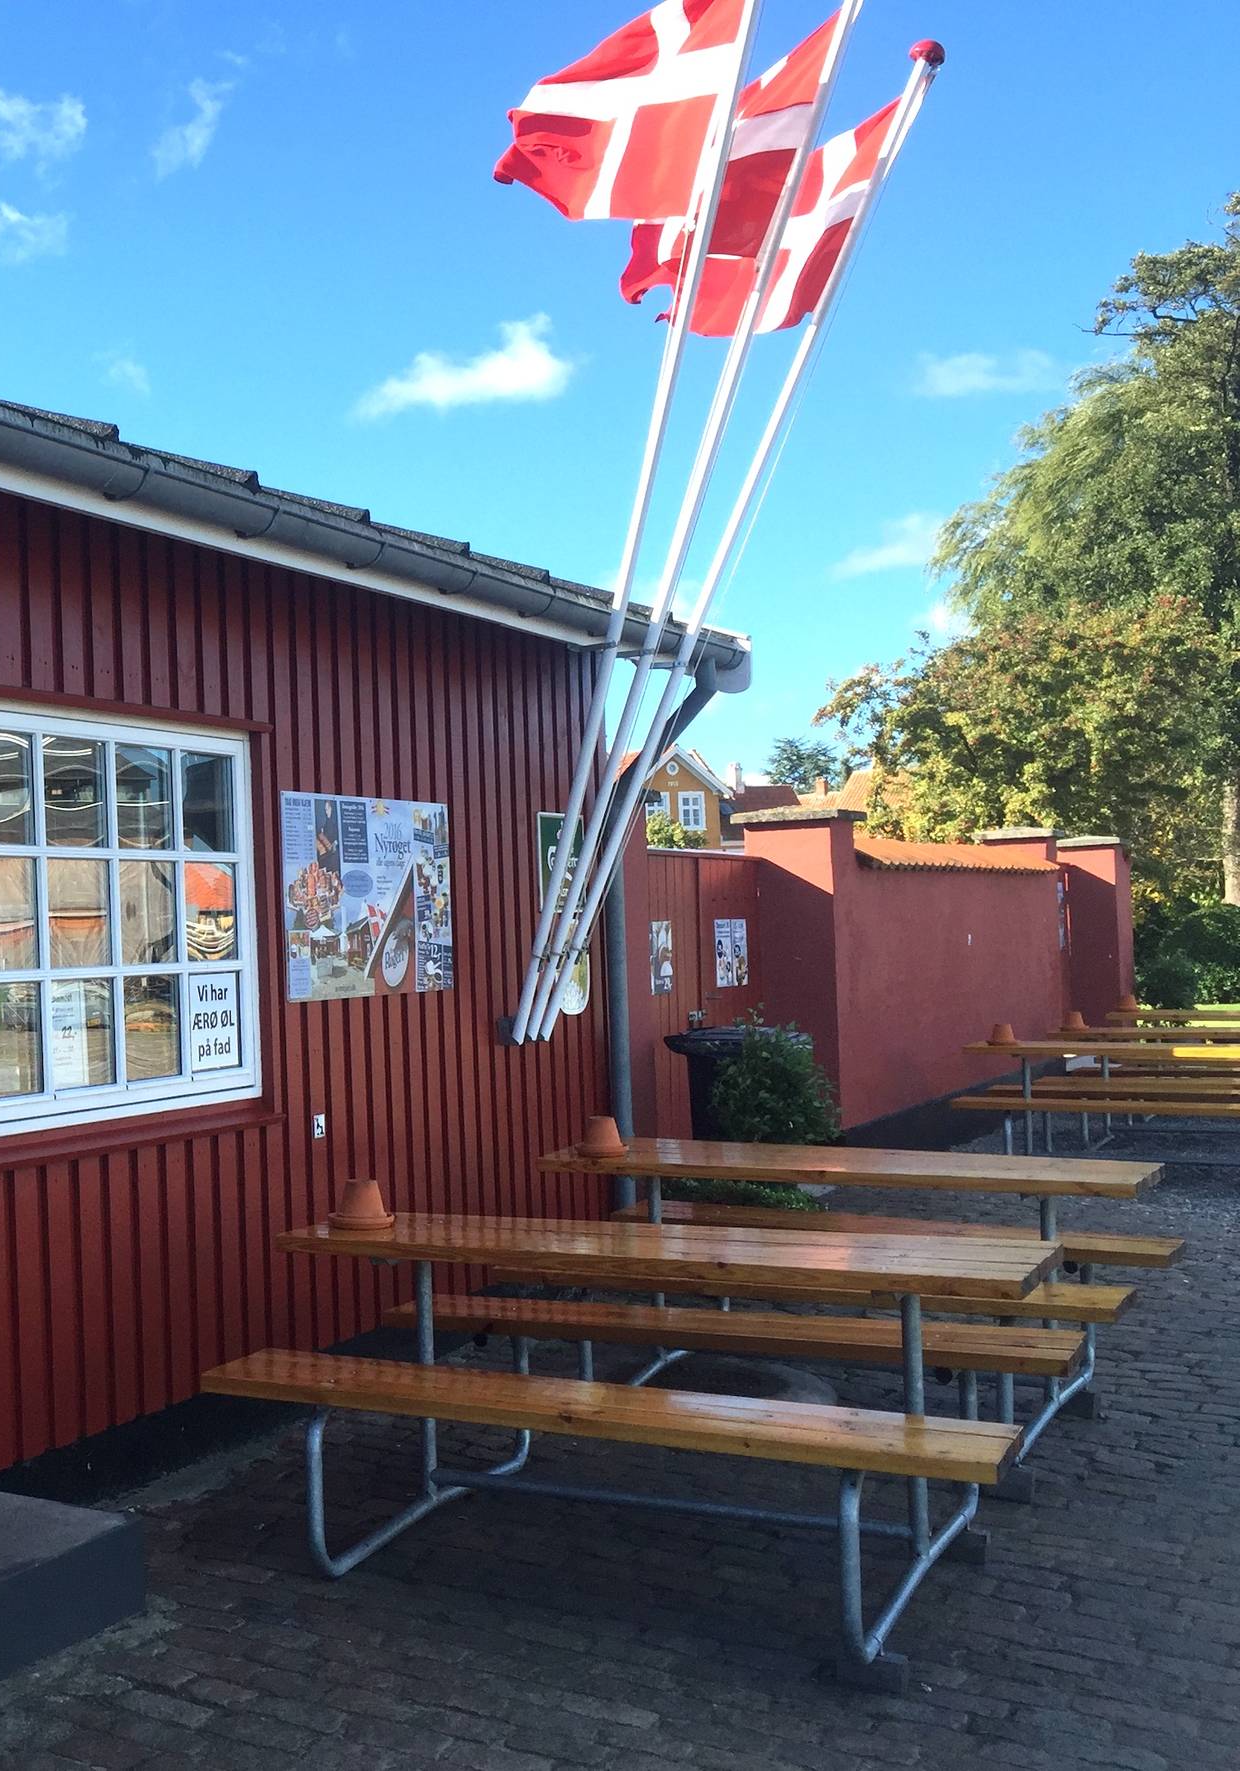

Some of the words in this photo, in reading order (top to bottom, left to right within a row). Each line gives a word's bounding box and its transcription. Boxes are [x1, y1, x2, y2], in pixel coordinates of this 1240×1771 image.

[374, 832, 412, 860] Nyrøget
[197, 984, 208, 1002] Vi
[210, 984, 228, 1001] har
[192, 1010, 218, 1031] ÆRØ
[220, 1010, 235, 1028] ØL
[198, 1038, 211, 1062] på
[213, 1036, 231, 1055] fad
